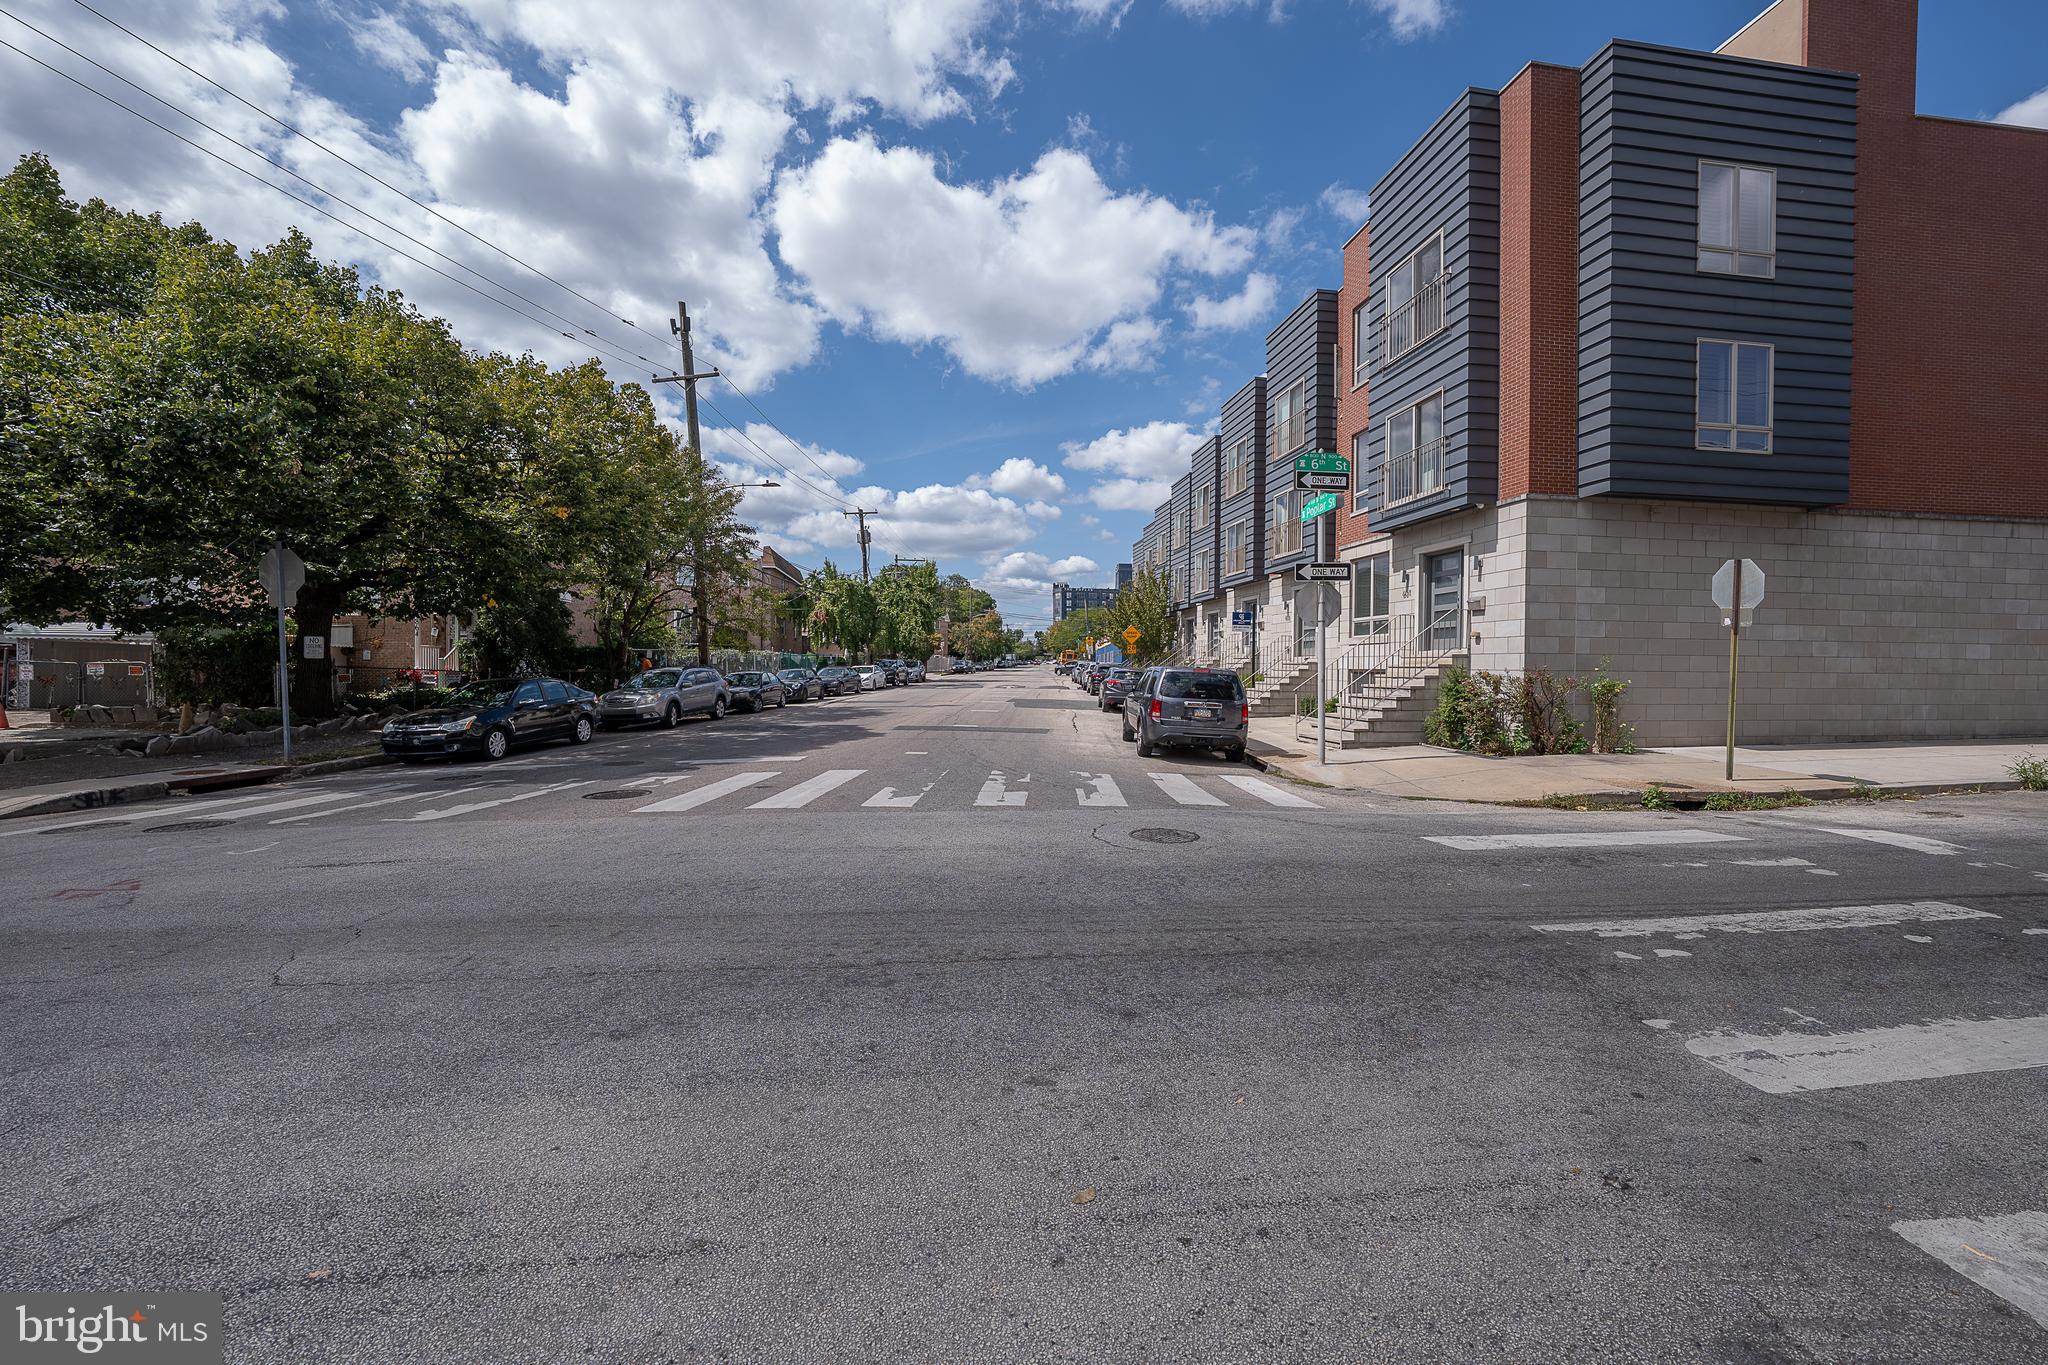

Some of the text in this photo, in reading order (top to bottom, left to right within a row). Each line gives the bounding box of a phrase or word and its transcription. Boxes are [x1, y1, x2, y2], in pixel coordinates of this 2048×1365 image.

[1311, 458, 1347, 470] 6th St
[1312, 477, 1327, 485] ONE
[1307, 502, 1326, 518] Poplar
[1328, 497, 1335, 508] St
[1312, 568, 1345, 576] ONE WAY
